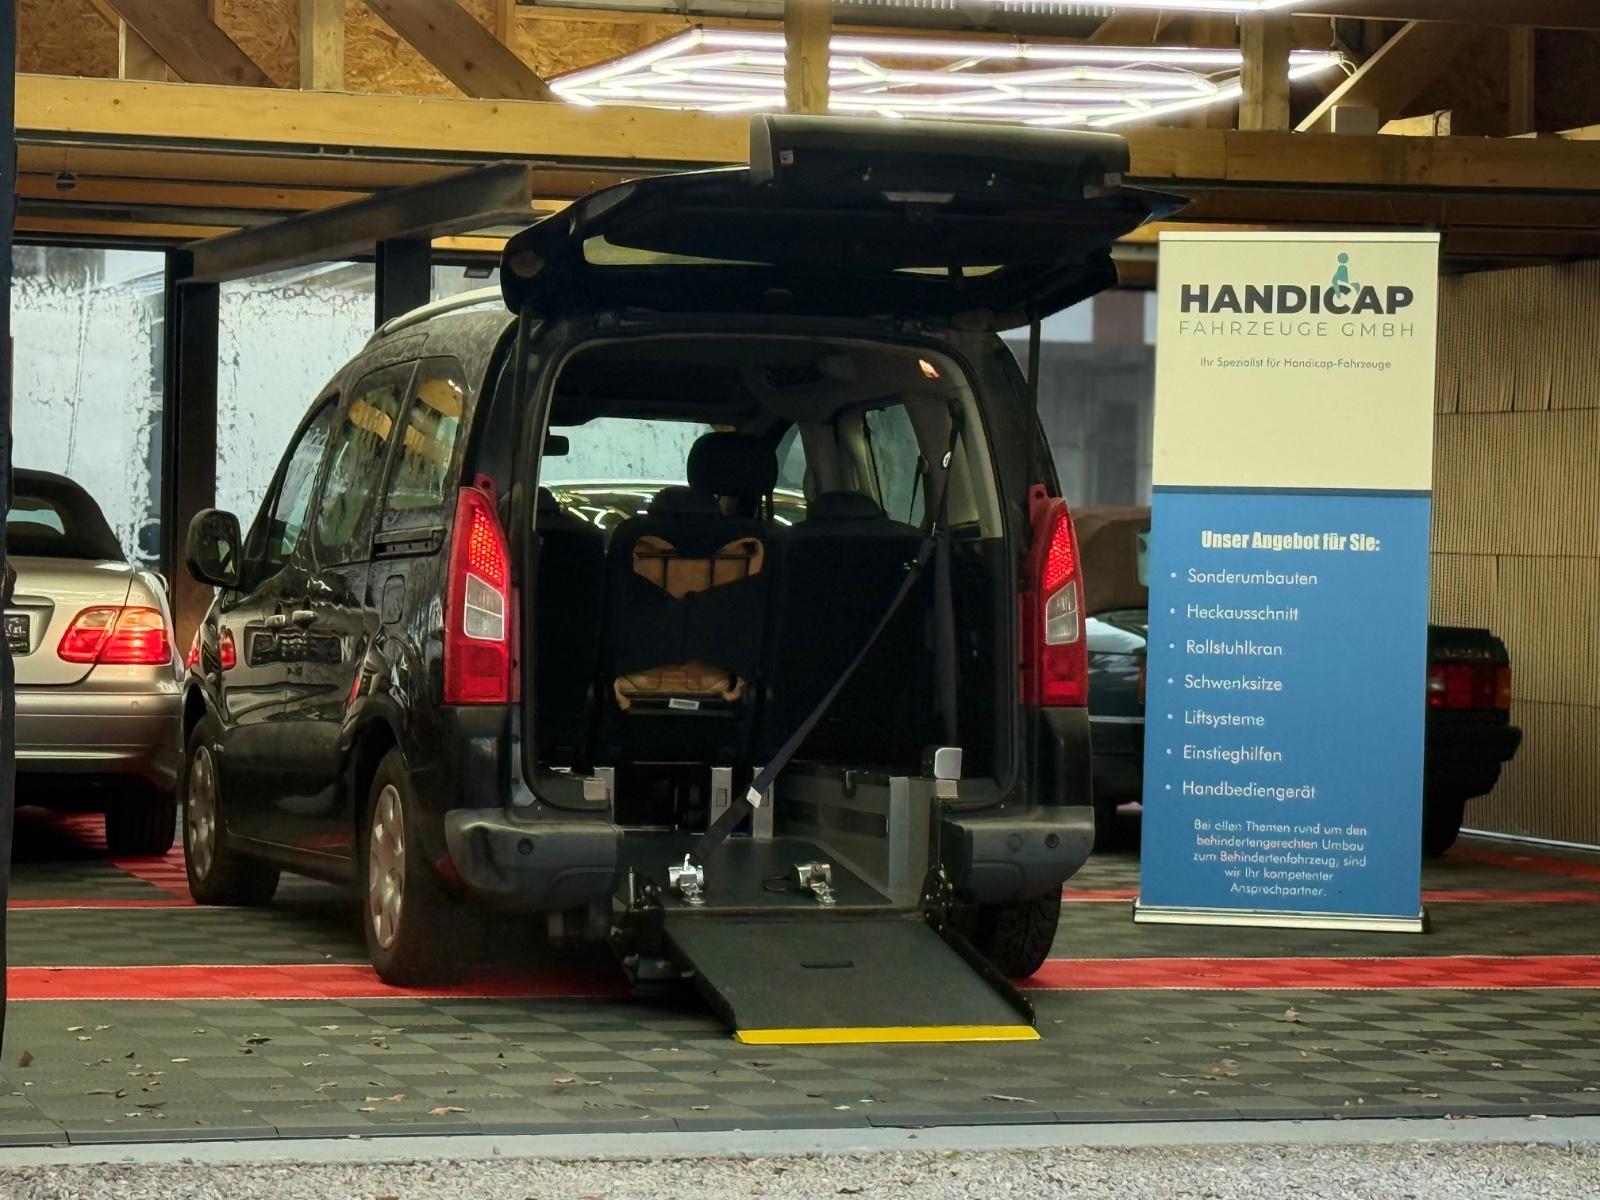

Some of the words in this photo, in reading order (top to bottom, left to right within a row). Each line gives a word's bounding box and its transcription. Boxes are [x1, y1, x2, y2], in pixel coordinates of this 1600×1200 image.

[1180, 284, 1414, 315] HANDICAP
[1179, 321, 1328, 336] FAHRZEUGE
[1341, 322, 1413, 337] GMBH
[1200, 357, 1214, 367] Ihr
[1217, 357, 1264, 369] Spezialist
[1266, 357, 1280, 368] für
[1284, 359, 1392, 371] Handicap-Fahrzeuge
[1201, 530, 1250, 549] Unser
[1251, 531, 1320, 551] Angebot
[1322, 533, 1347, 550] für
[1349, 533, 1381, 551] Sie:
[1188, 569, 1318, 585] Sonderumbauten
[1187, 604, 1299, 621] Heckausschnitt
[1186, 640, 1283, 656] Rollstuhlkran
[1184, 675, 1283, 691] Schwenksitze
[1184, 710, 1265, 729] Liftsysteme
[1183, 745, 1282, 764] Einstieghilfen
[1182, 781, 1316, 801] Handbediengerät
[1194, 819, 1211, 831] Bei
[1215, 820, 1242, 831] allen
[1246, 821, 1291, 833] Themen
[1294, 824, 1321, 834] rund
[1324, 827, 1343, 835] um
[1346, 824, 1368, 836] den
[1196, 834, 1318, 849] behindertengerechten
[1322, 839, 1364, 851] Umbau
[1193, 852, 1217, 861] zum
[1220, 850, 1339, 868] Behindertenfahrzeug,
[1343, 856, 1367, 867] sind
[1225, 866, 1241, 877] wir
[1245, 866, 1259, 877] Ihr
[1263, 866, 1334, 881] kompetenter
[1230, 882, 1327, 897] Ansprechpartner.
